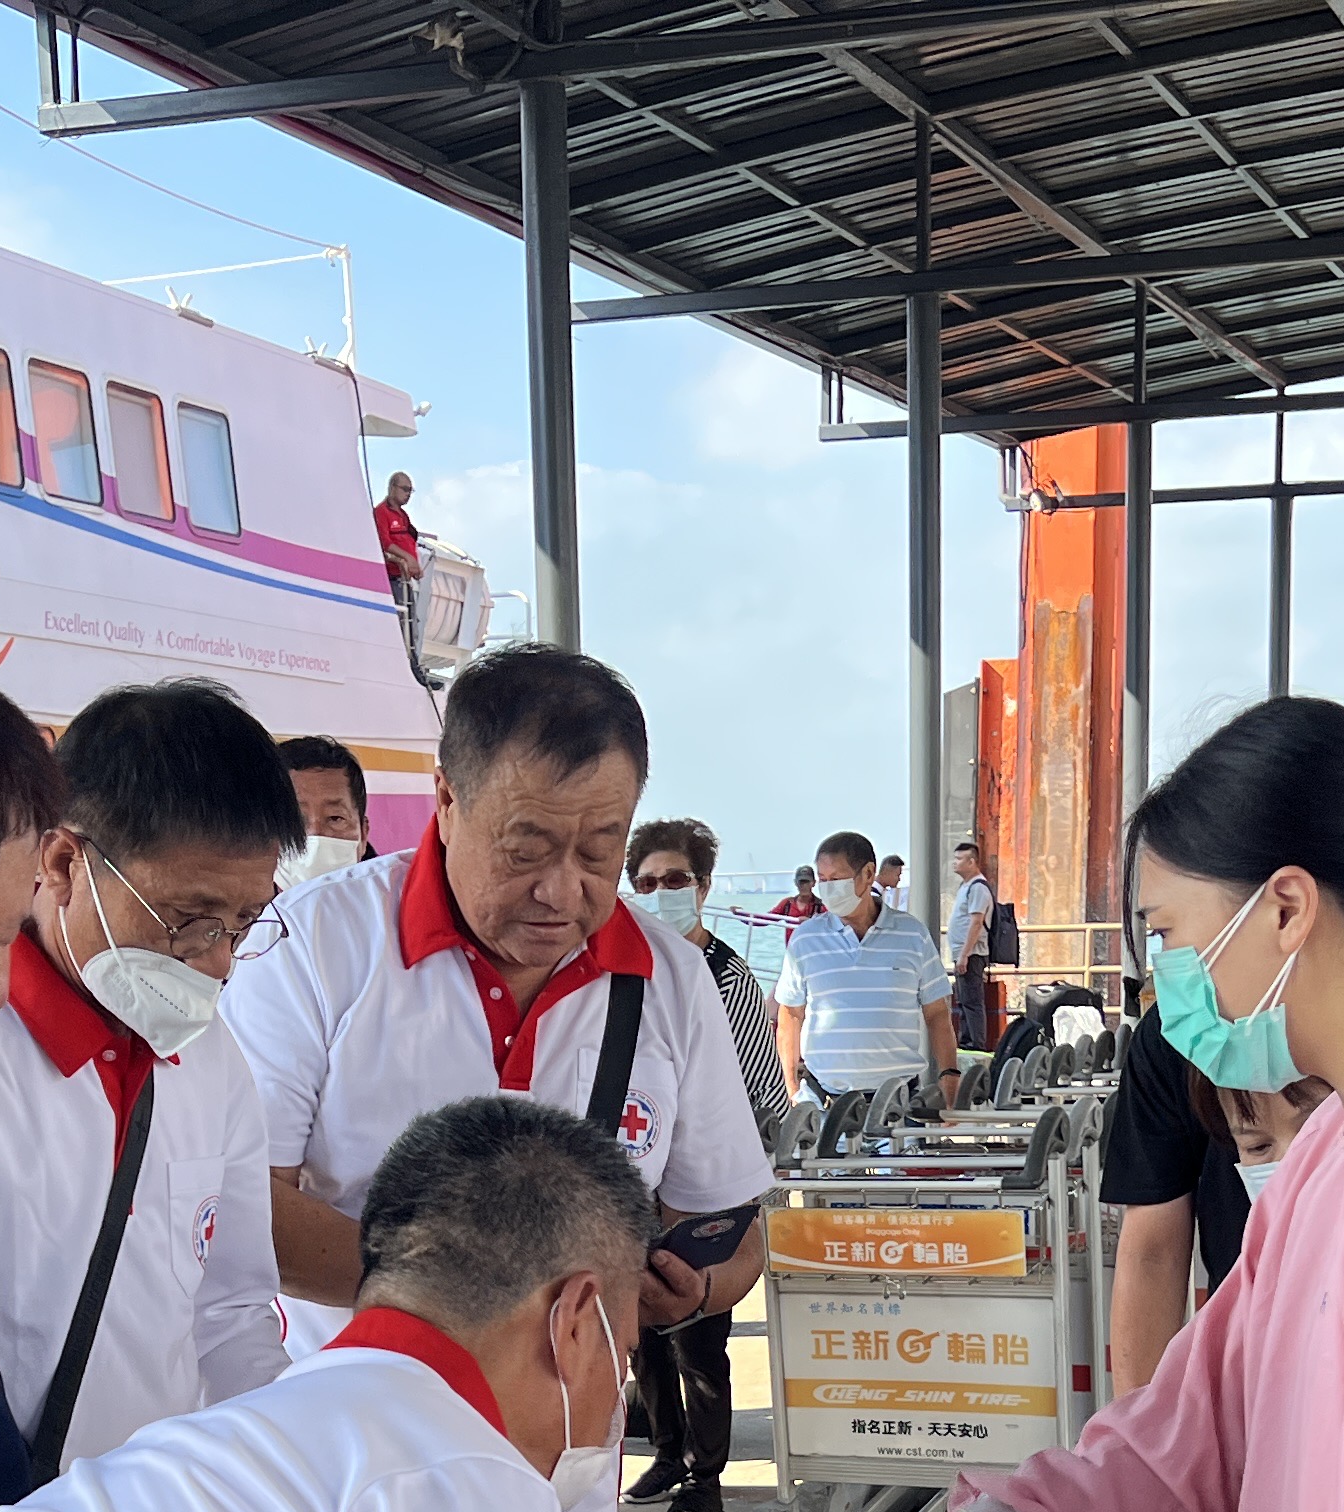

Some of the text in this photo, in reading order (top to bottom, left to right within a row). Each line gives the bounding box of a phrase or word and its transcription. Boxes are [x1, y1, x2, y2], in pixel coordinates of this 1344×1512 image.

[44, 610, 331, 673] Excellent Quality A Comfortable Voyage Experience
[823, 1241, 969, 1265] 正新 輪胎
[808, 1301, 902, 1316] 世界知名商標
[810, 1329, 1030, 1366] 正新 輪胎
[812, 1383, 1030, 1407] CHENG SHIN TIRE
[876, 1446, 965, 1459] www.cst.com.tw
